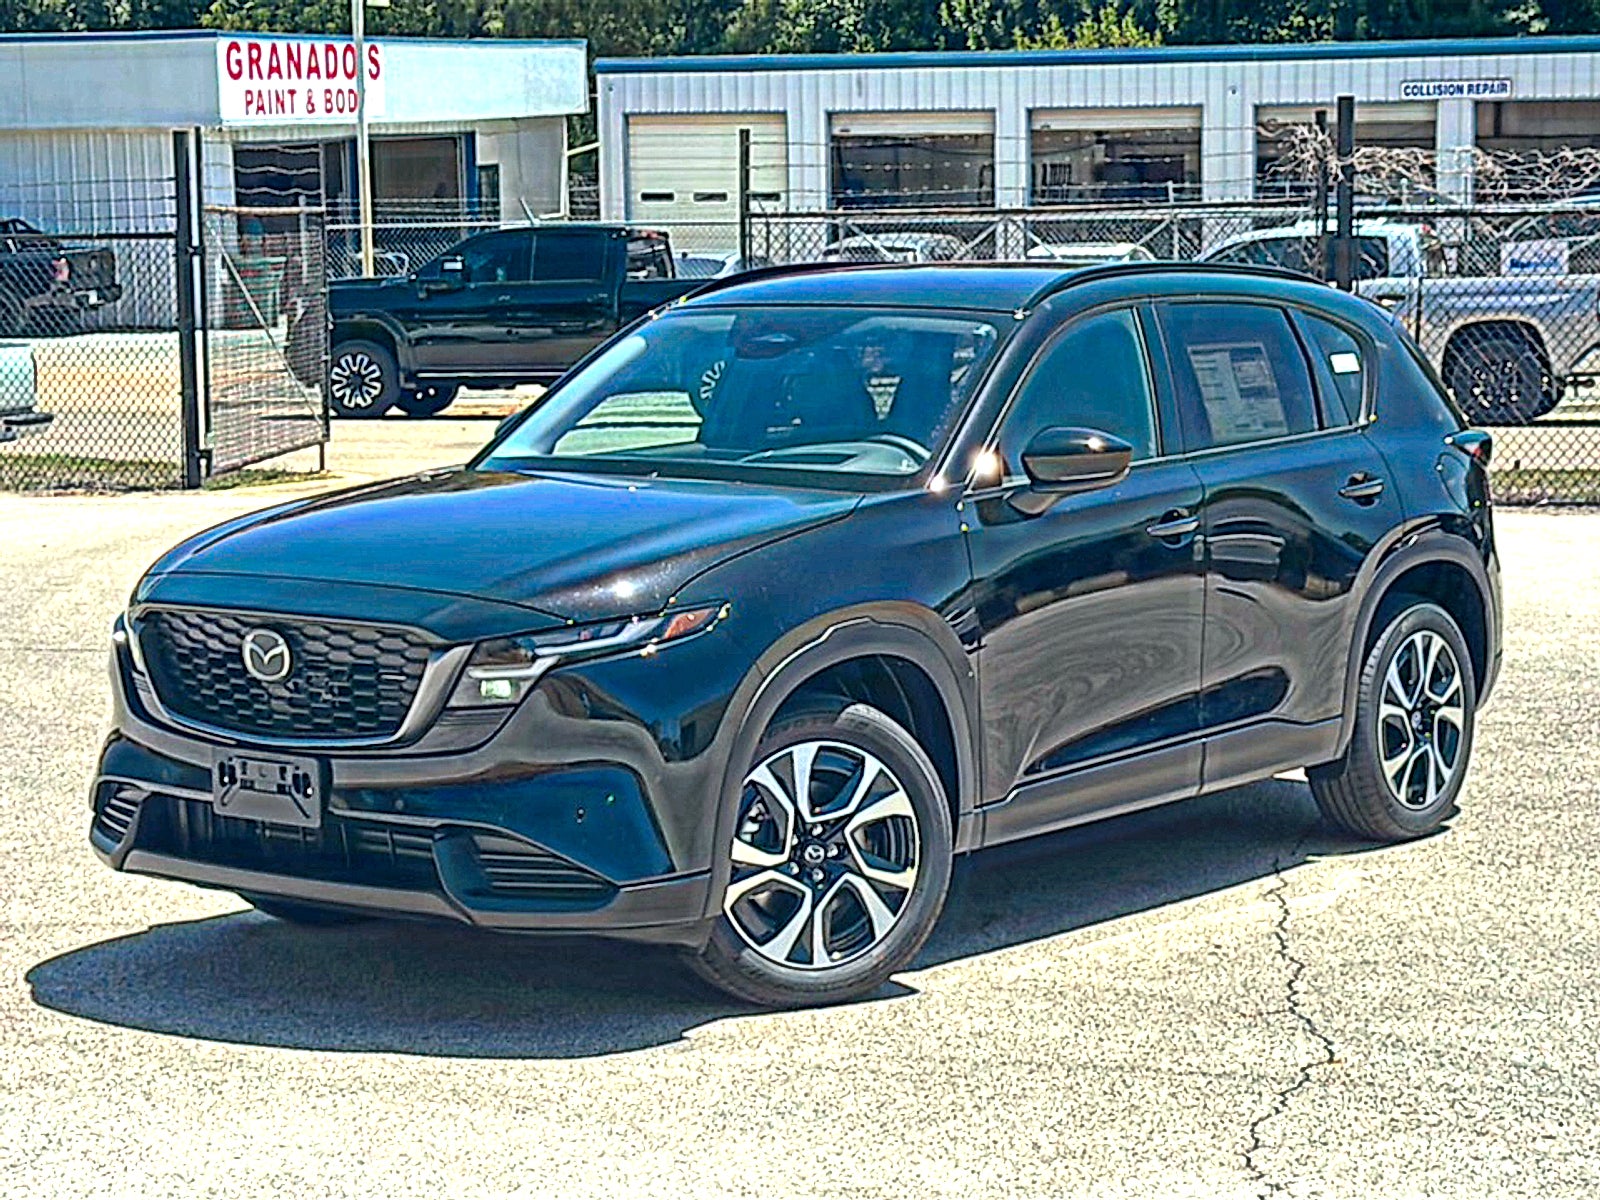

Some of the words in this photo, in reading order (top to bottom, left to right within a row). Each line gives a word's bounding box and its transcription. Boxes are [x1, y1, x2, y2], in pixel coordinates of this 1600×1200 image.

[1403, 84, 1464, 97] COLLISION
[1467, 83, 1508, 95] REPAIR
[245, 89, 296, 115] PAINT
[306, 88, 316, 114] &
[324, 88, 362, 114] BOD
